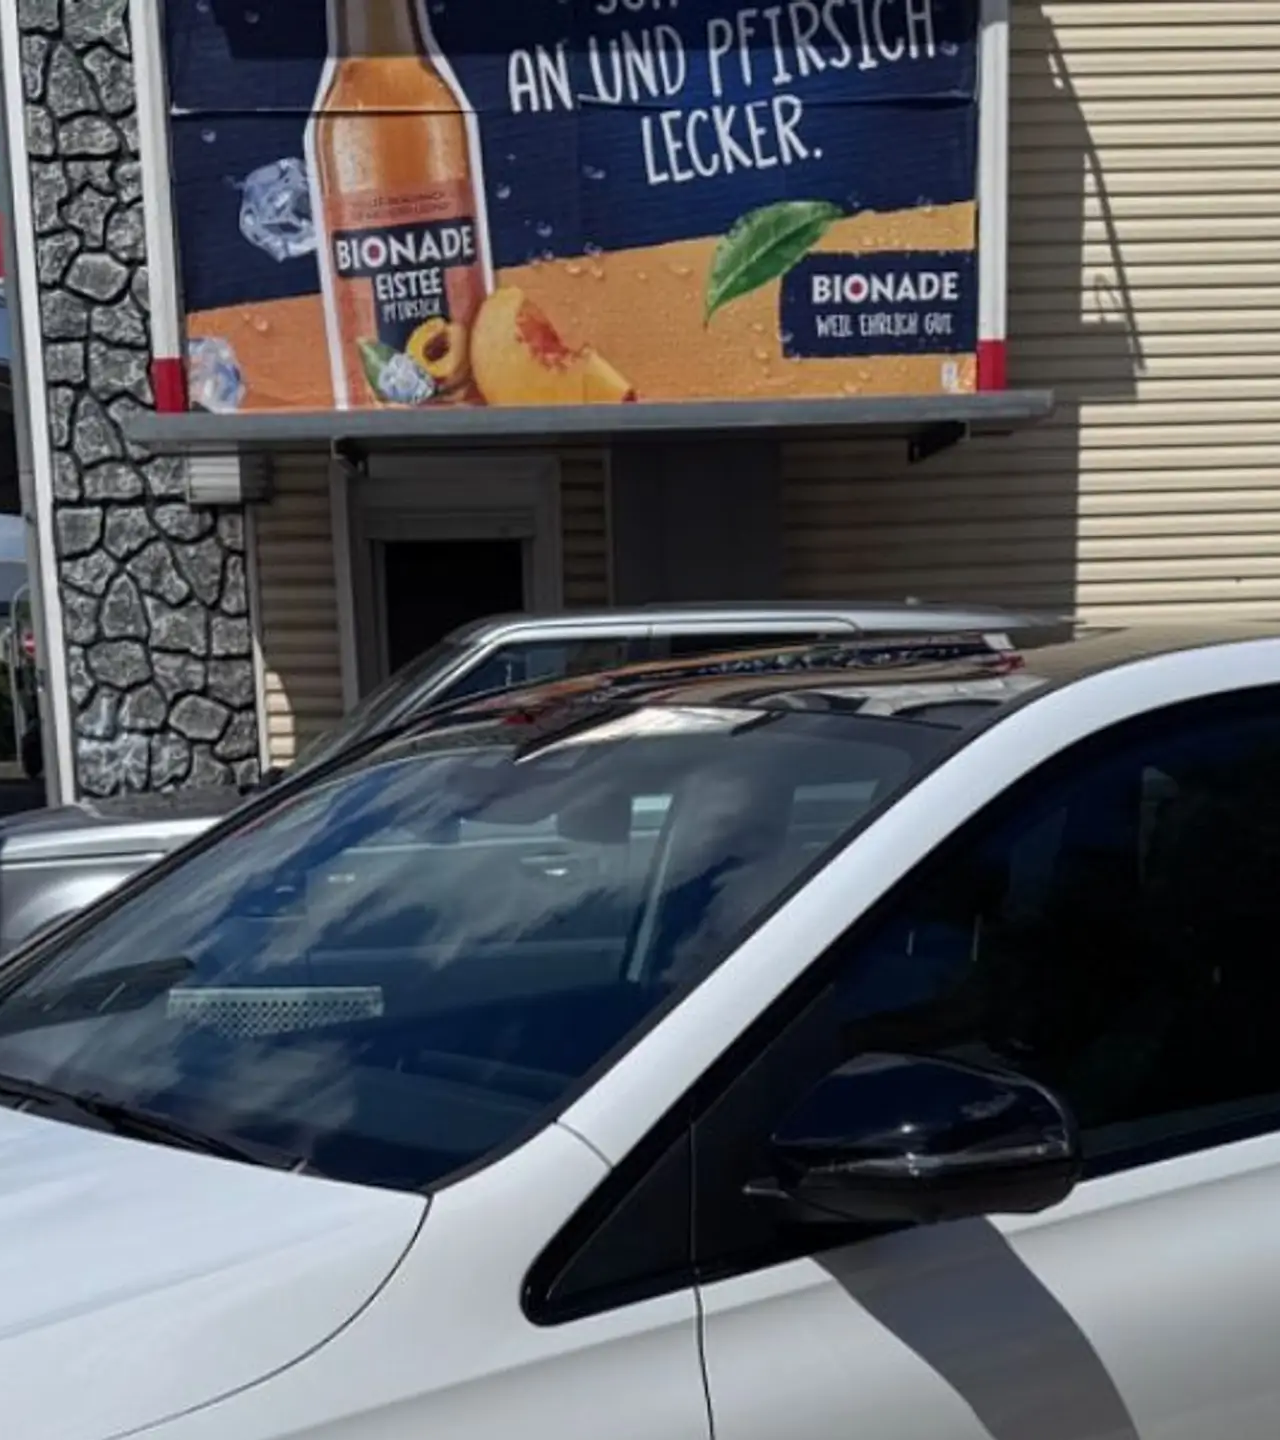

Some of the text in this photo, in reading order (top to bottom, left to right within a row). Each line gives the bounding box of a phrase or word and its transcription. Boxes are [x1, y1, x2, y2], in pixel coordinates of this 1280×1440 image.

[508, 0, 935, 113] AN UND PFIRSICH
[641, 94, 823, 185] LECKER.
[335, 225, 476, 271] BIONADE
[375, 267, 443, 300] EISTEE
[811, 271, 960, 304] BIONADE
[816, 313, 854, 338] WEIL
[858, 311, 919, 336] EHRLICH
